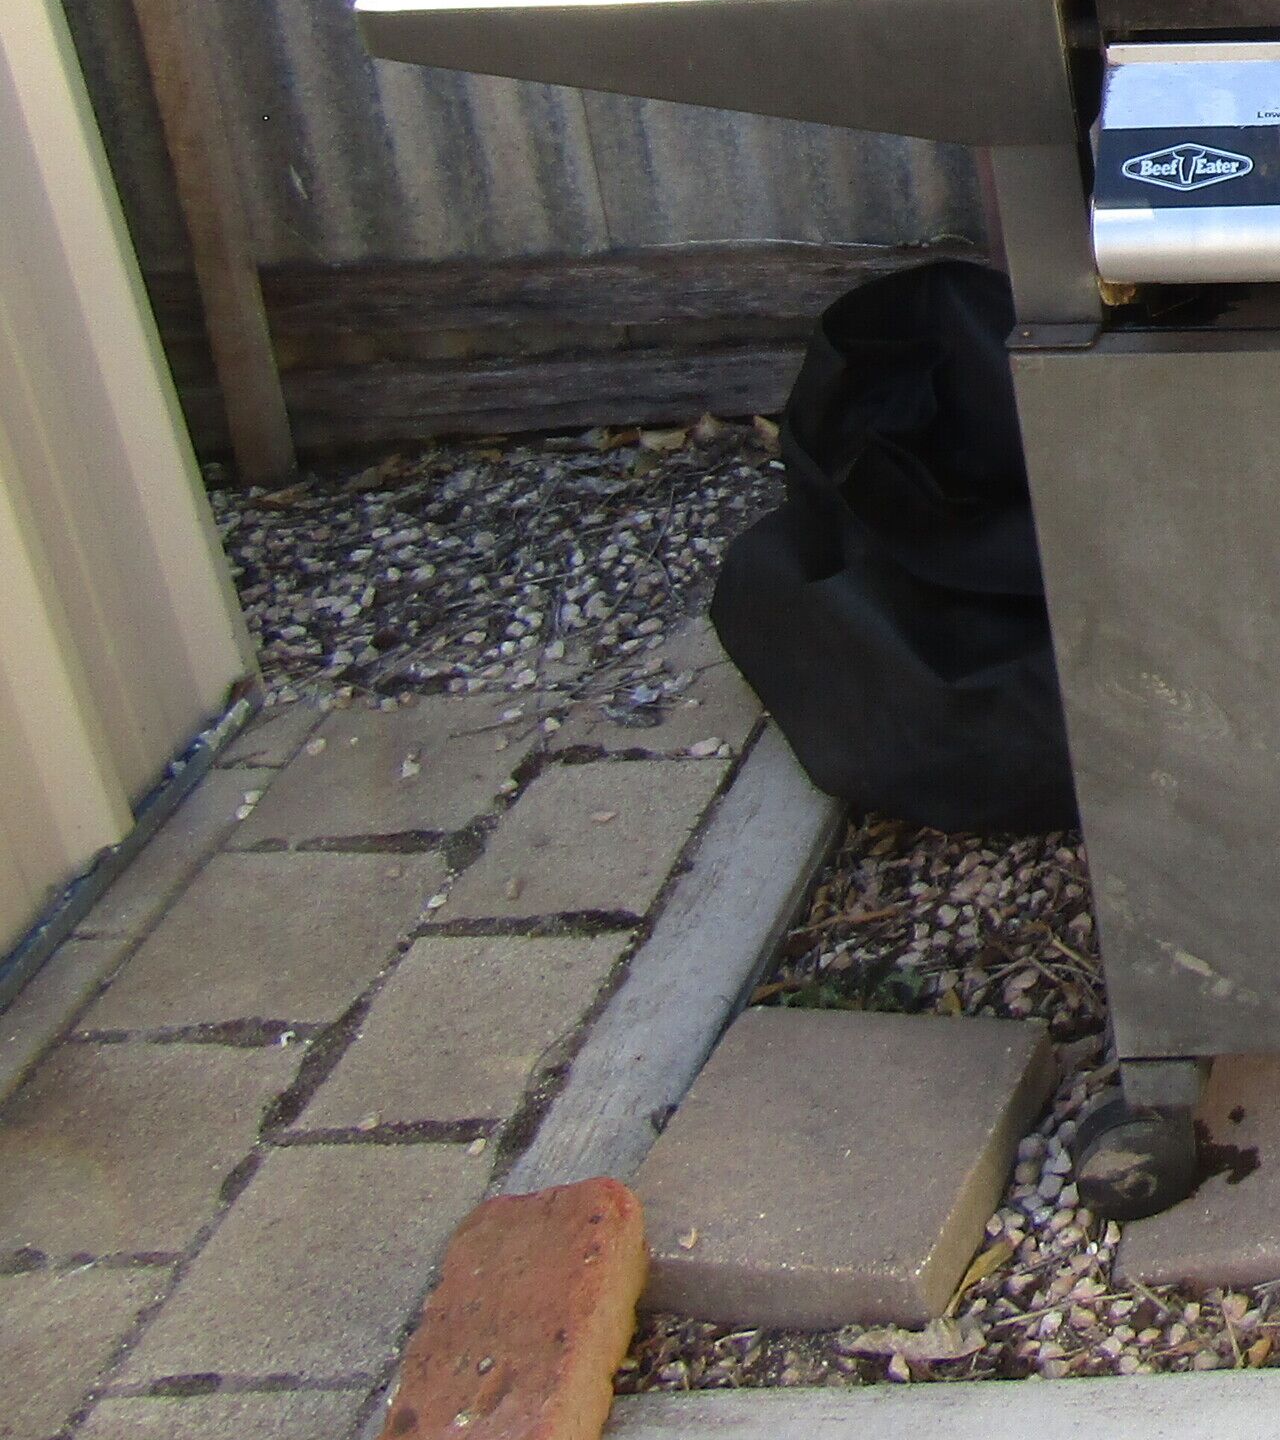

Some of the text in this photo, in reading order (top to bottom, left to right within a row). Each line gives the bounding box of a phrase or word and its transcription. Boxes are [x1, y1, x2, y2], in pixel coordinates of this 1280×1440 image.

[1257, 111, 1280, 119] Low
[1140, 158, 1239, 176] Beef Eater
